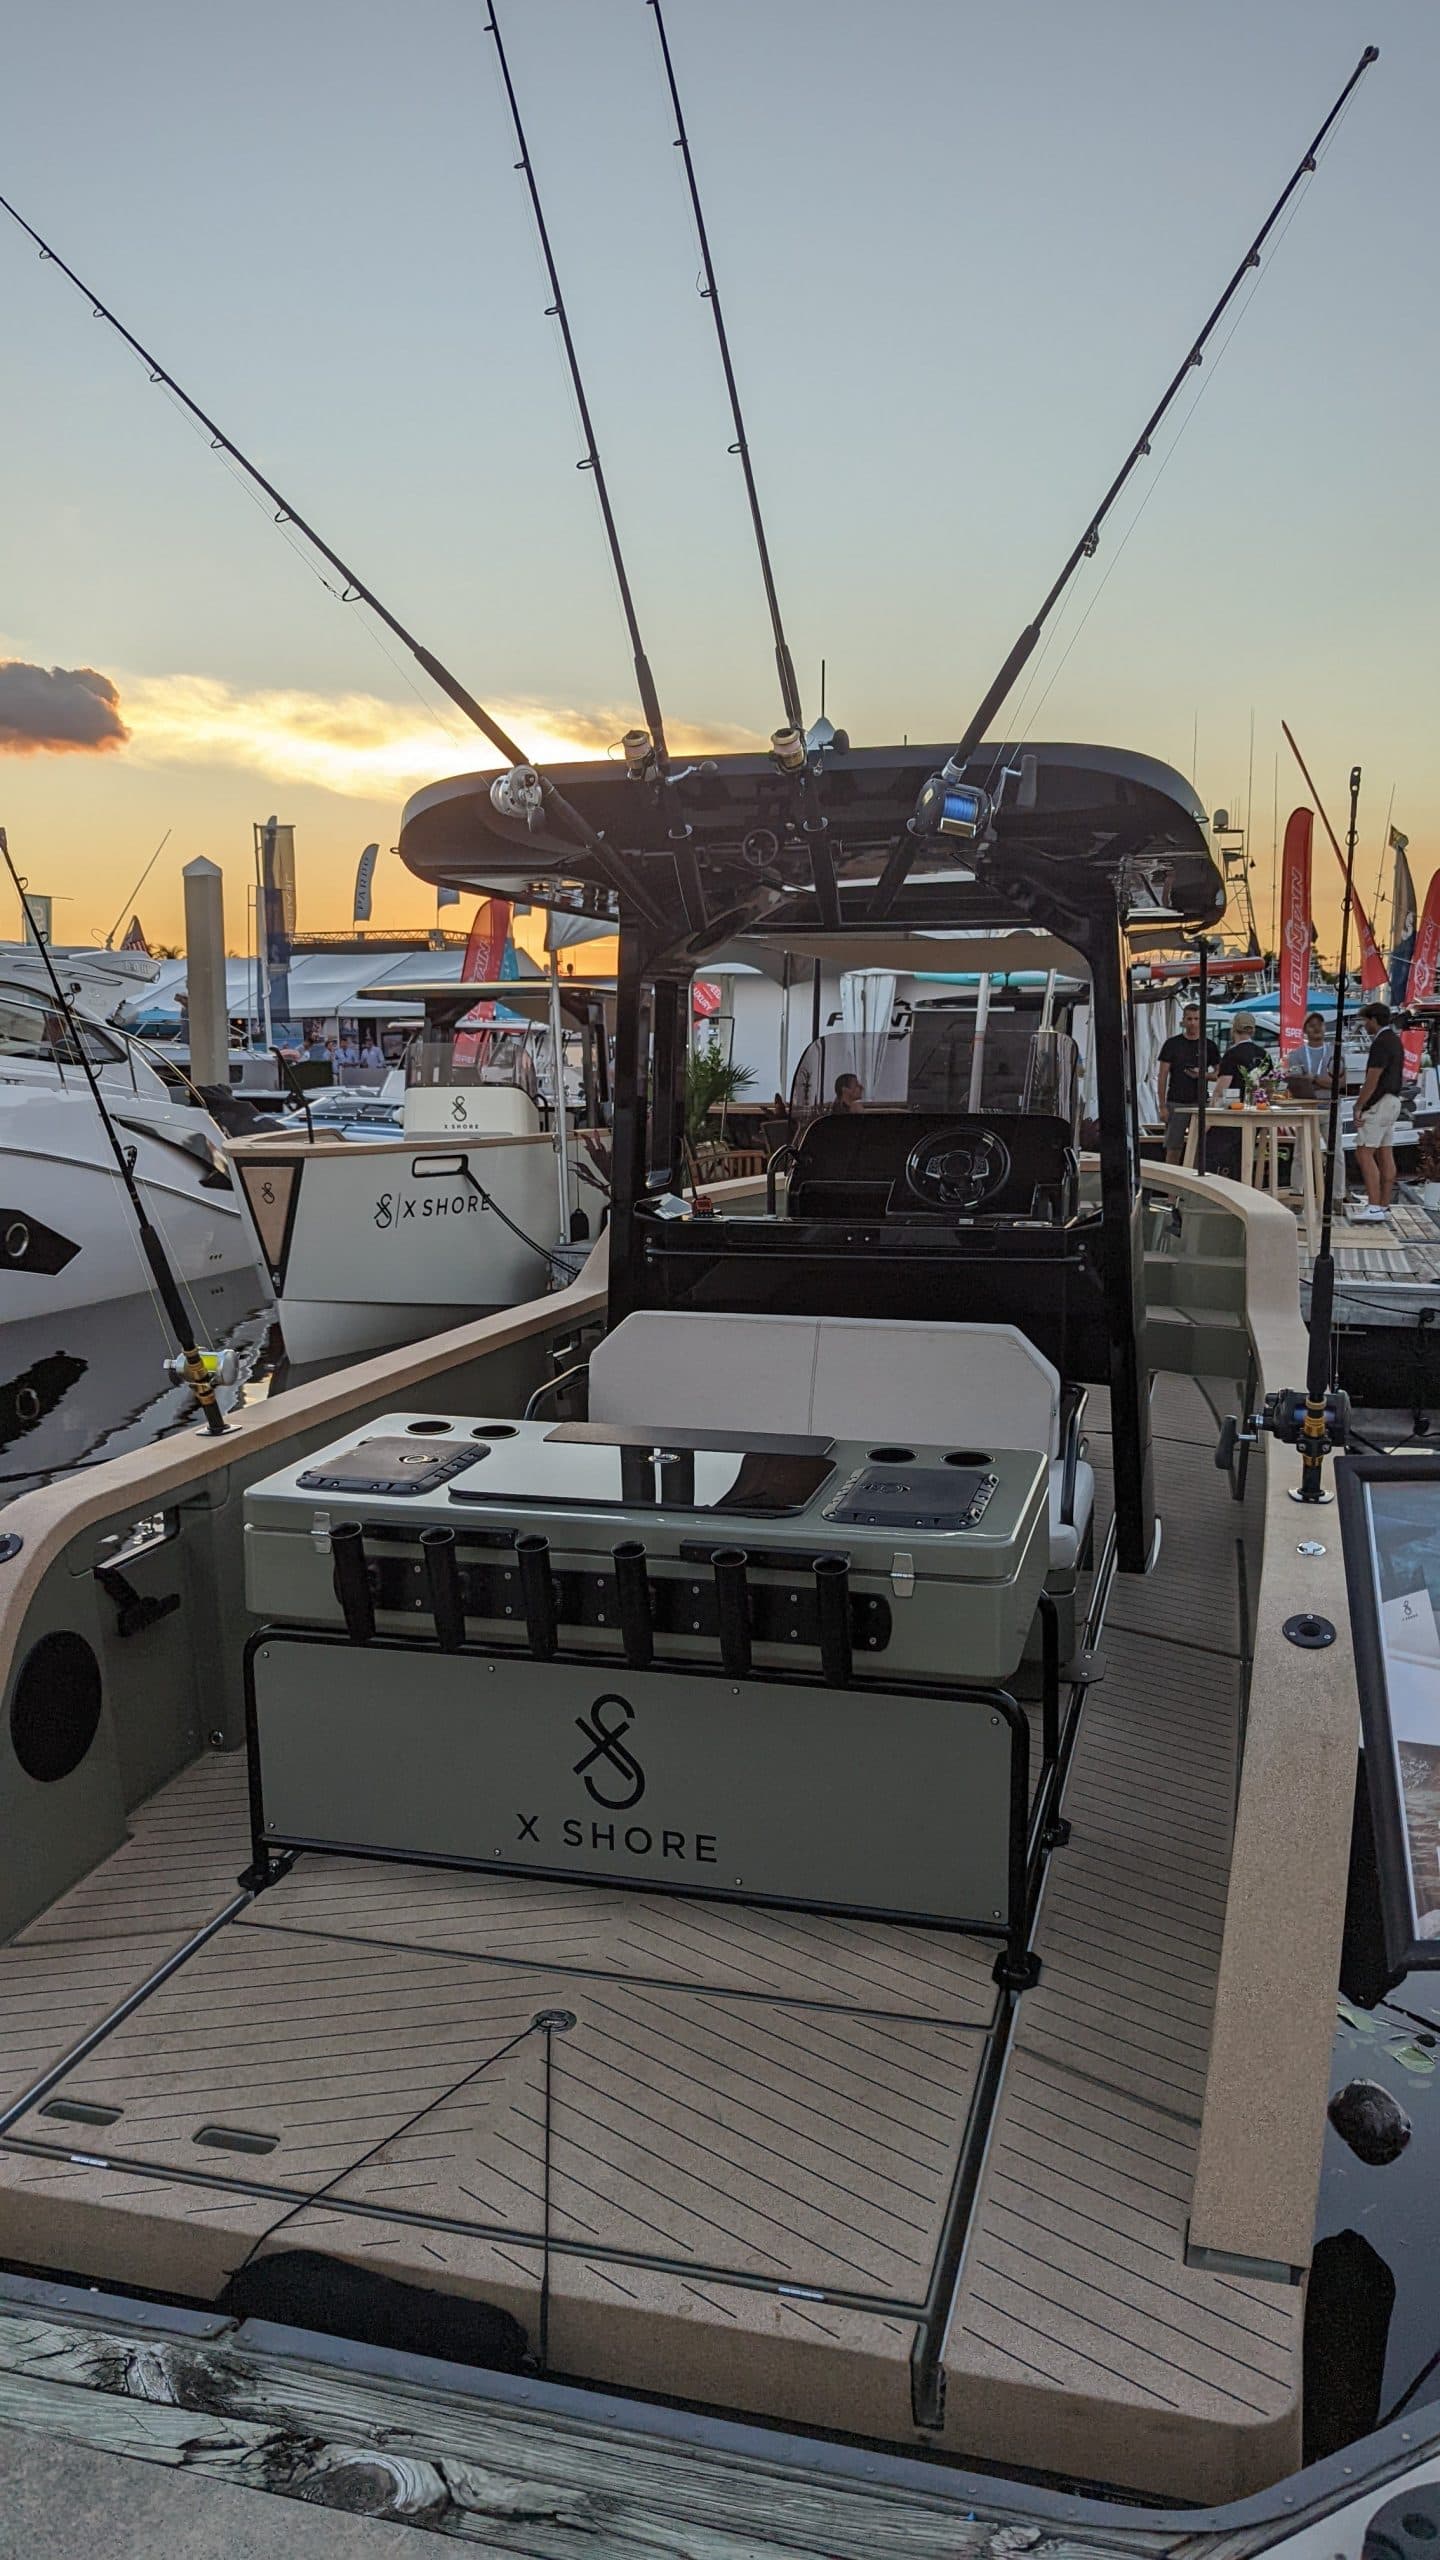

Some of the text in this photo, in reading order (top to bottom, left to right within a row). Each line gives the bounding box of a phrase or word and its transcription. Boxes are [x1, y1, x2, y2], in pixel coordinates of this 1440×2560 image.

[1289, 866, 1306, 1006] FOUNTAIN
[1285, 1027, 1303, 1038] SPE
[402, 1194, 490, 1219] X SHORE
[516, 1813, 718, 1864] X SHORE
